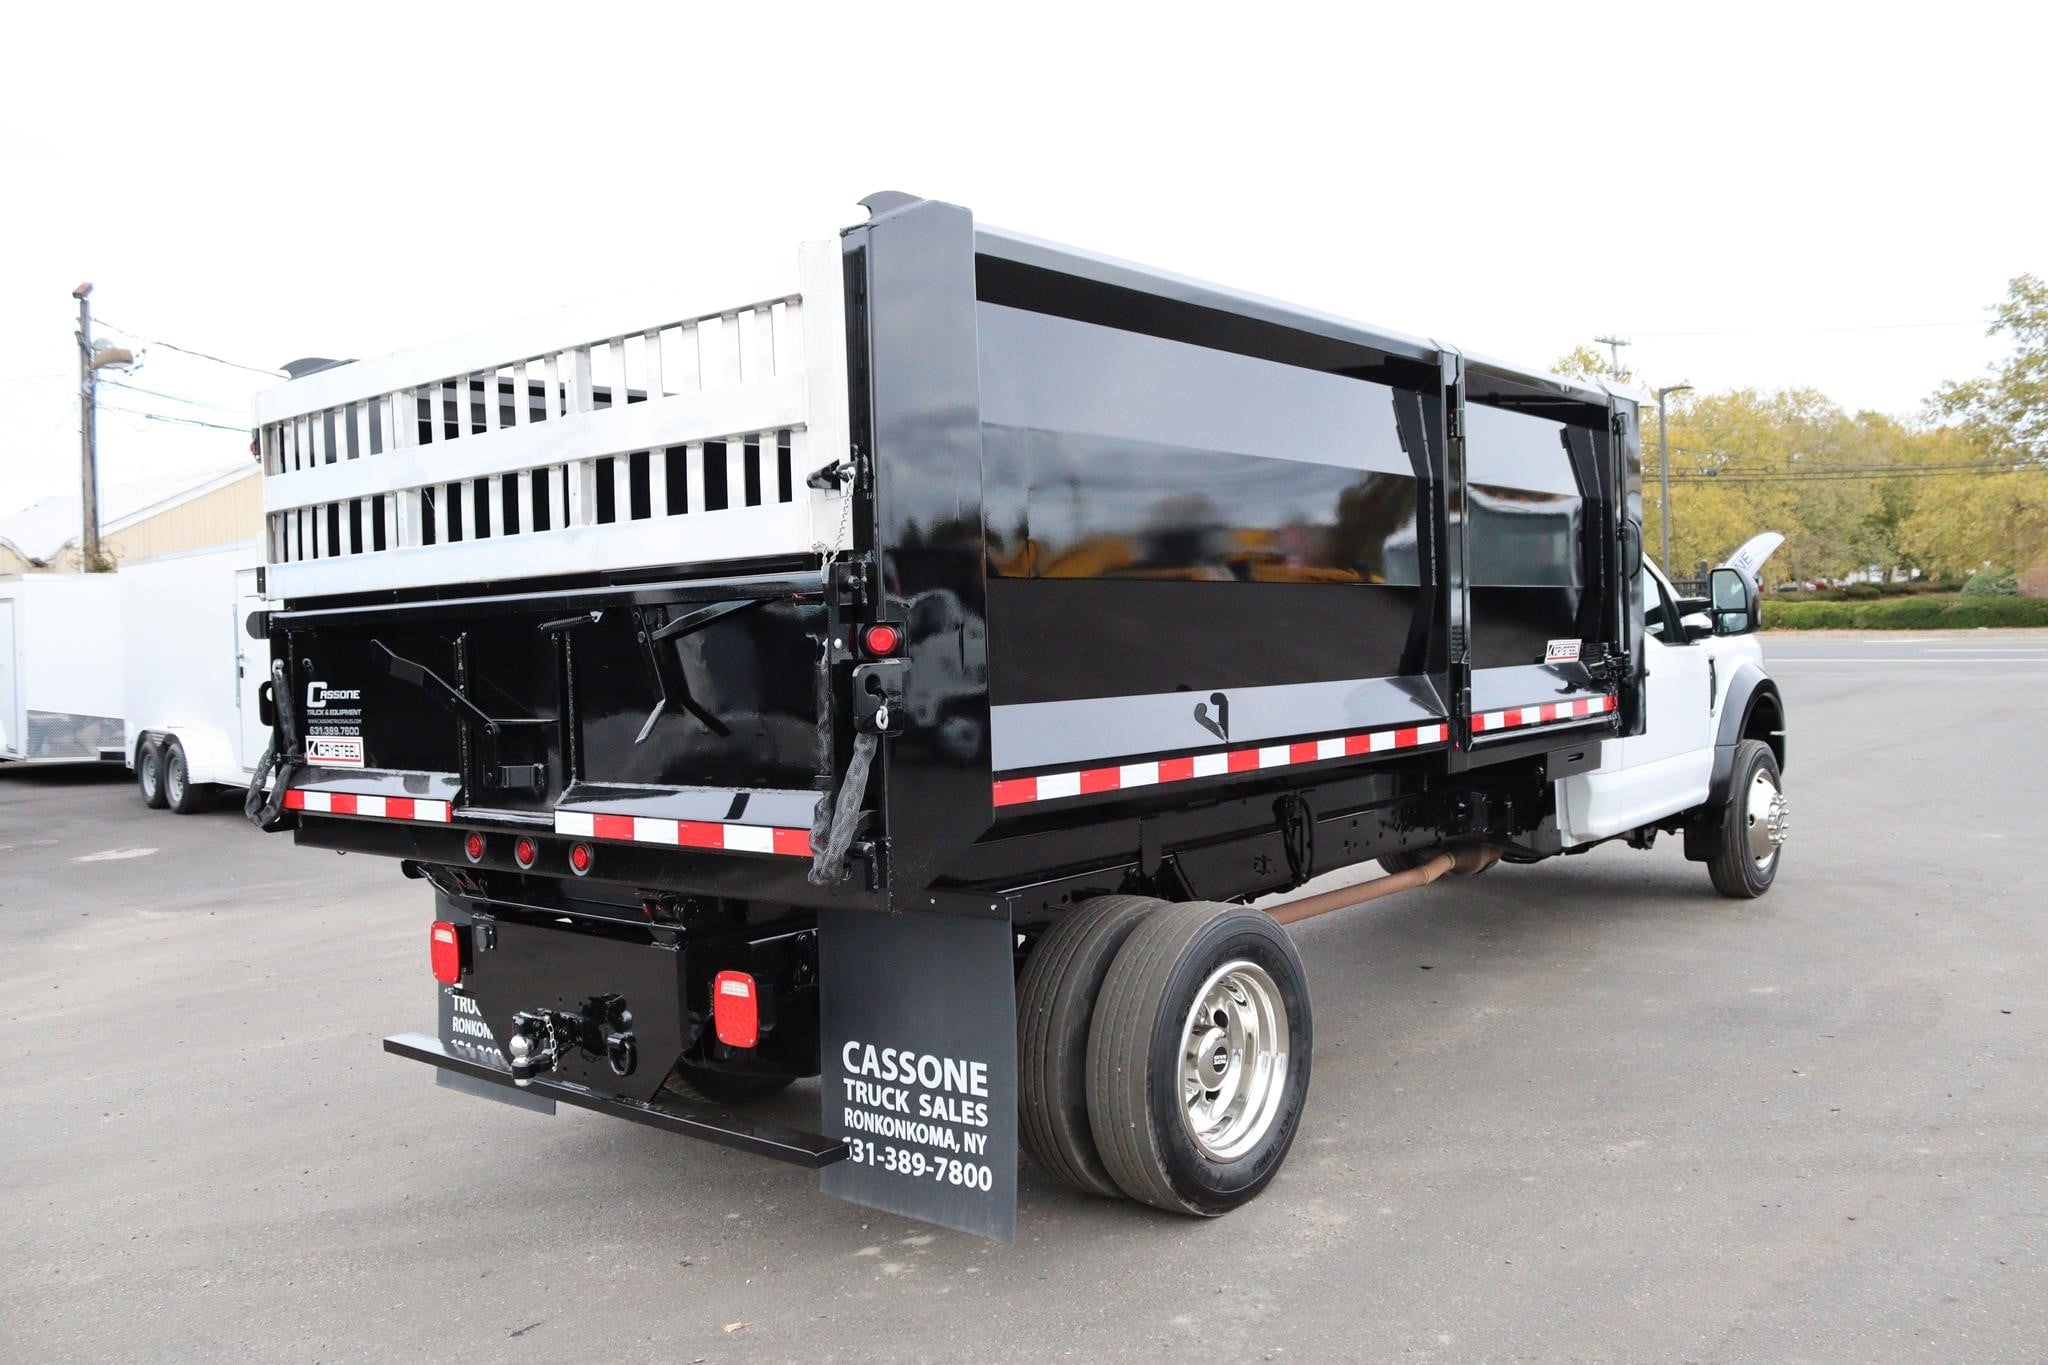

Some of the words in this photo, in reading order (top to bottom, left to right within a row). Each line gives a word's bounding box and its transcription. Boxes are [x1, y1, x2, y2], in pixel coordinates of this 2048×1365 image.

[307, 681, 361, 707] CASSONE
[309, 726, 360, 736] 631.389.7800
[319, 743, 359, 758] CRYSTEEL
[842, 1040, 989, 1098] CASSONE
[843, 1077, 911, 1114] TRUCK
[919, 1094, 989, 1127] SALES
[844, 1107, 961, 1154] RONKONKOMA,
[964, 1131, 988, 1156] NY
